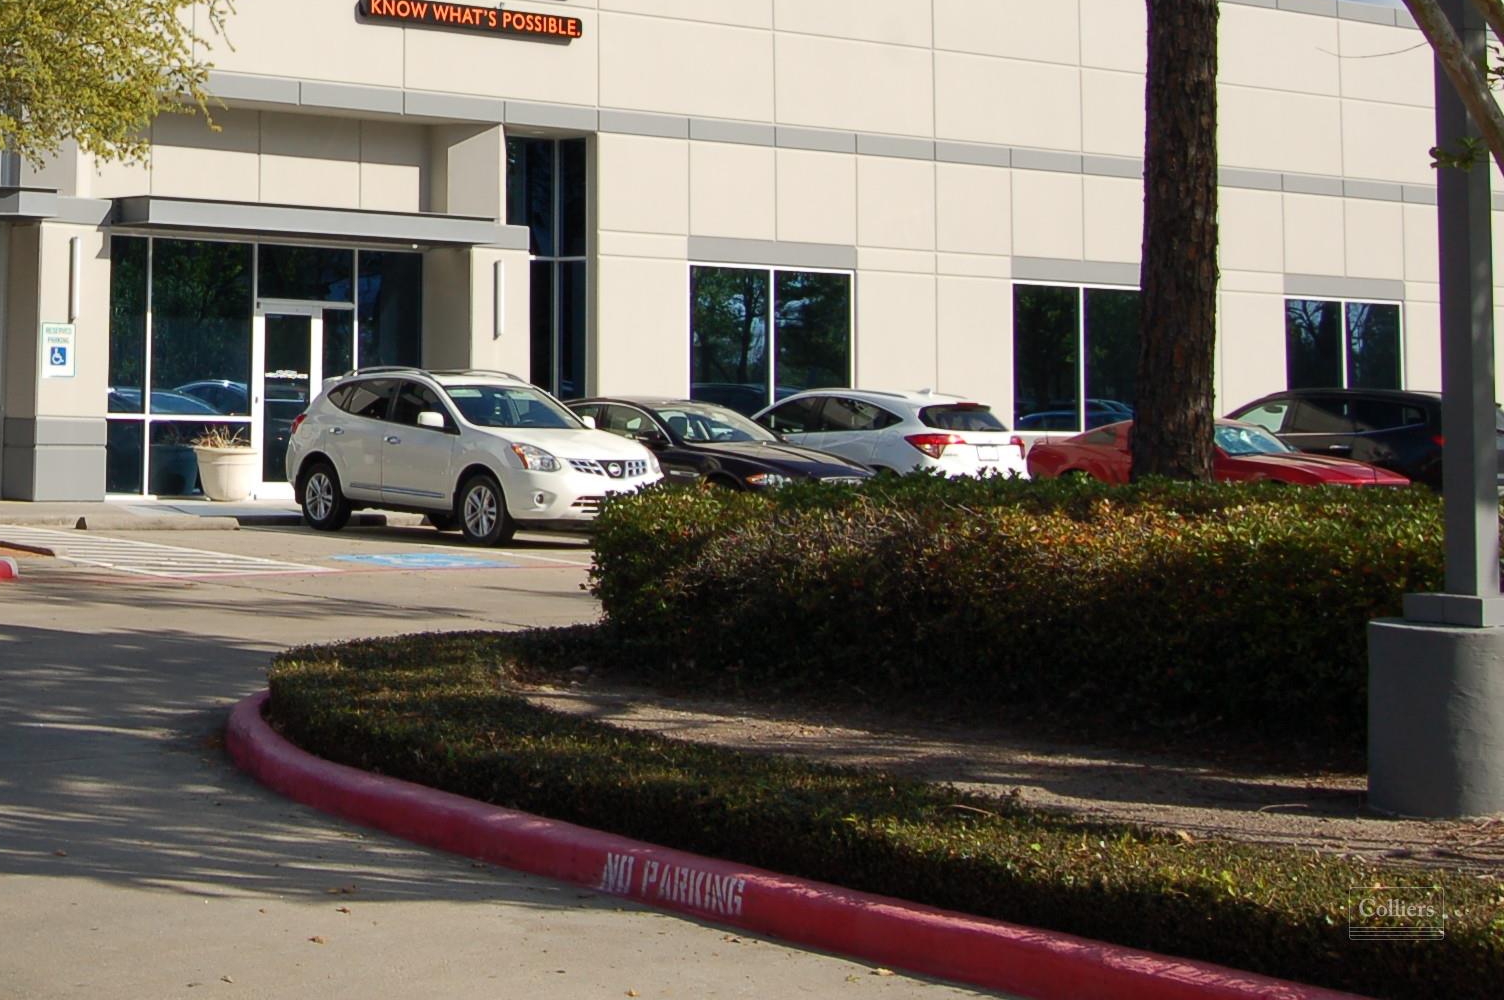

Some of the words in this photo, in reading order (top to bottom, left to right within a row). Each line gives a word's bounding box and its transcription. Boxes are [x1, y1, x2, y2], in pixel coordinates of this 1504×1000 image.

[432, 3, 497, 27] WHAT'S
[502, 12, 581, 37] POSSIBLE.
[599, 852, 635, 894] NO
[640, 859, 746, 916] PARKING
